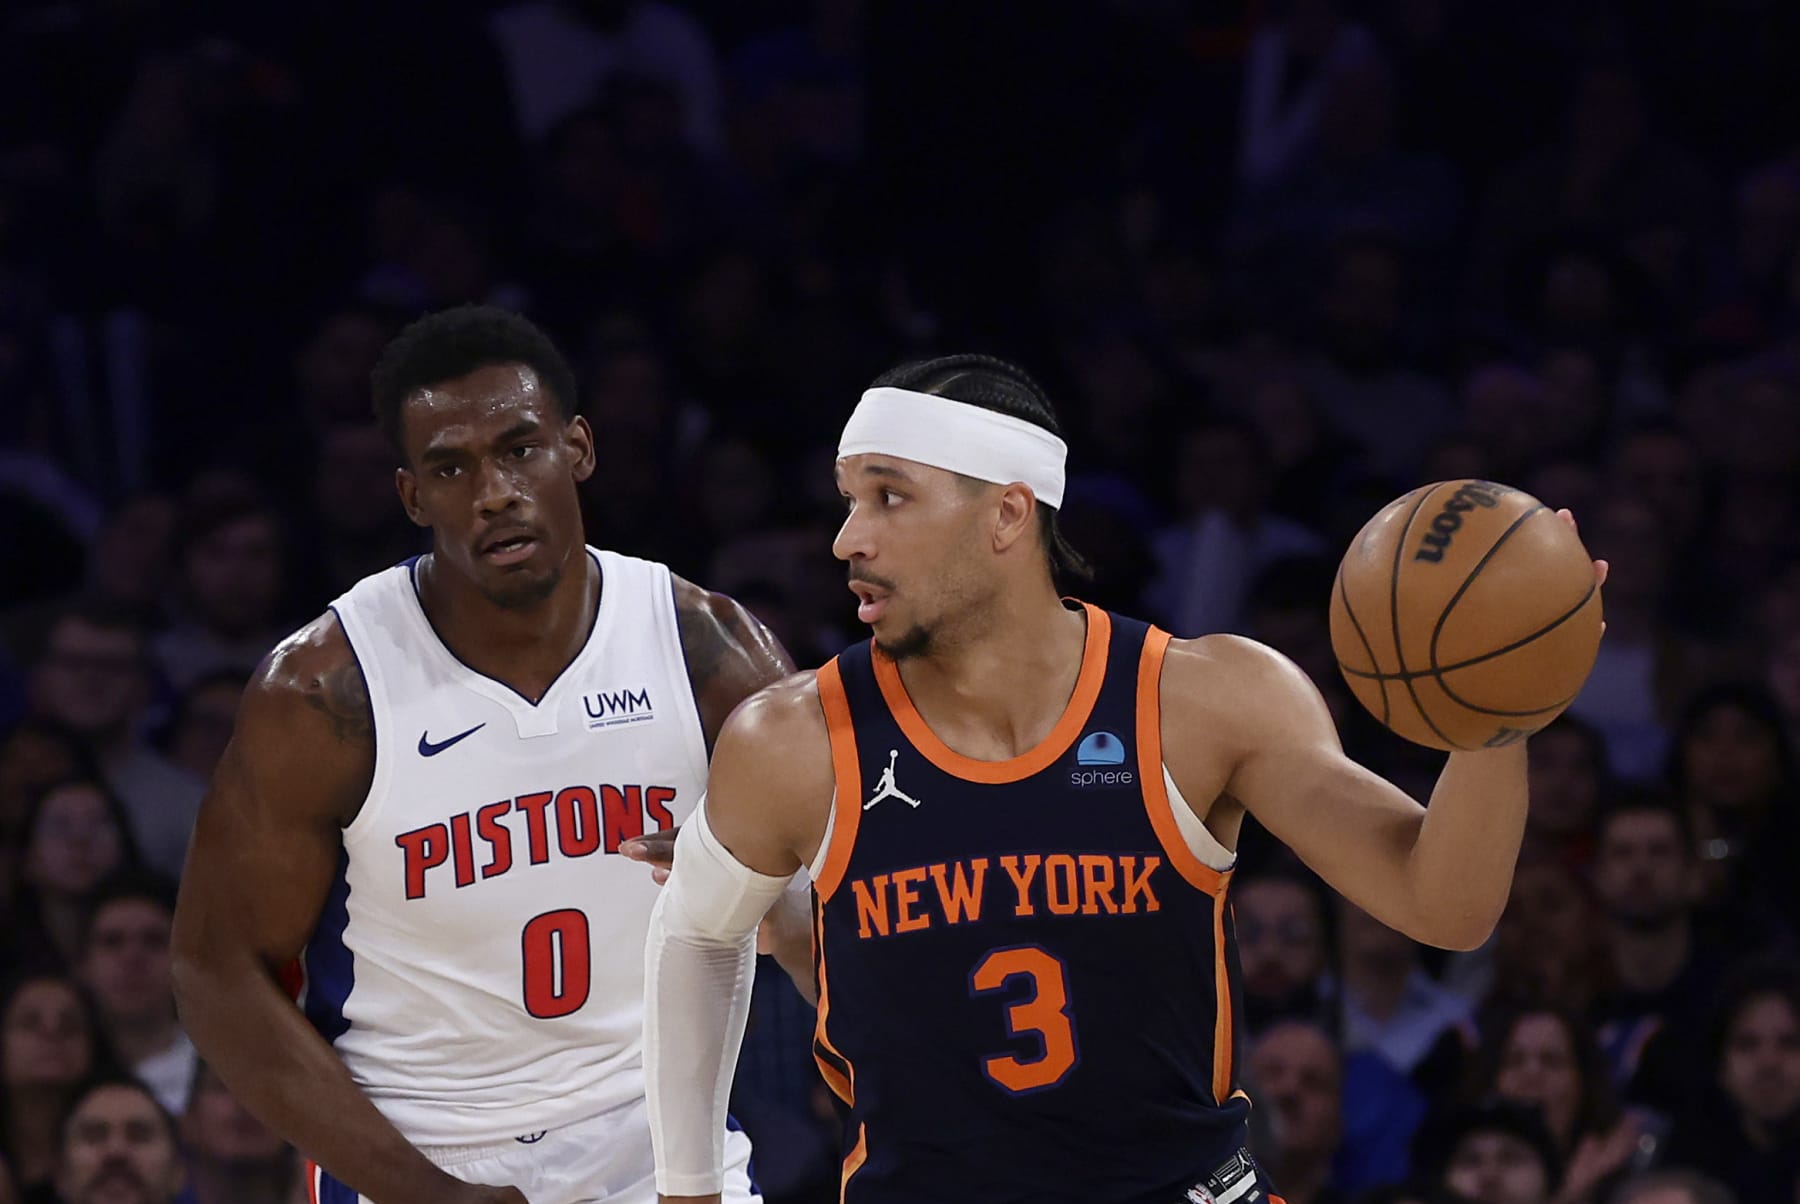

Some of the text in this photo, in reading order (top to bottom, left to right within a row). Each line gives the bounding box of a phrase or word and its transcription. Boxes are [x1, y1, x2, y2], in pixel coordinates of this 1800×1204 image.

[582, 687, 653, 719] UWM
[1071, 769, 1133, 788] sphere
[395, 783, 677, 901] PISTONS
[851, 853, 1161, 939] NEW YORK
[521, 907, 592, 1020] 0
[970, 945, 1078, 1094] 3
